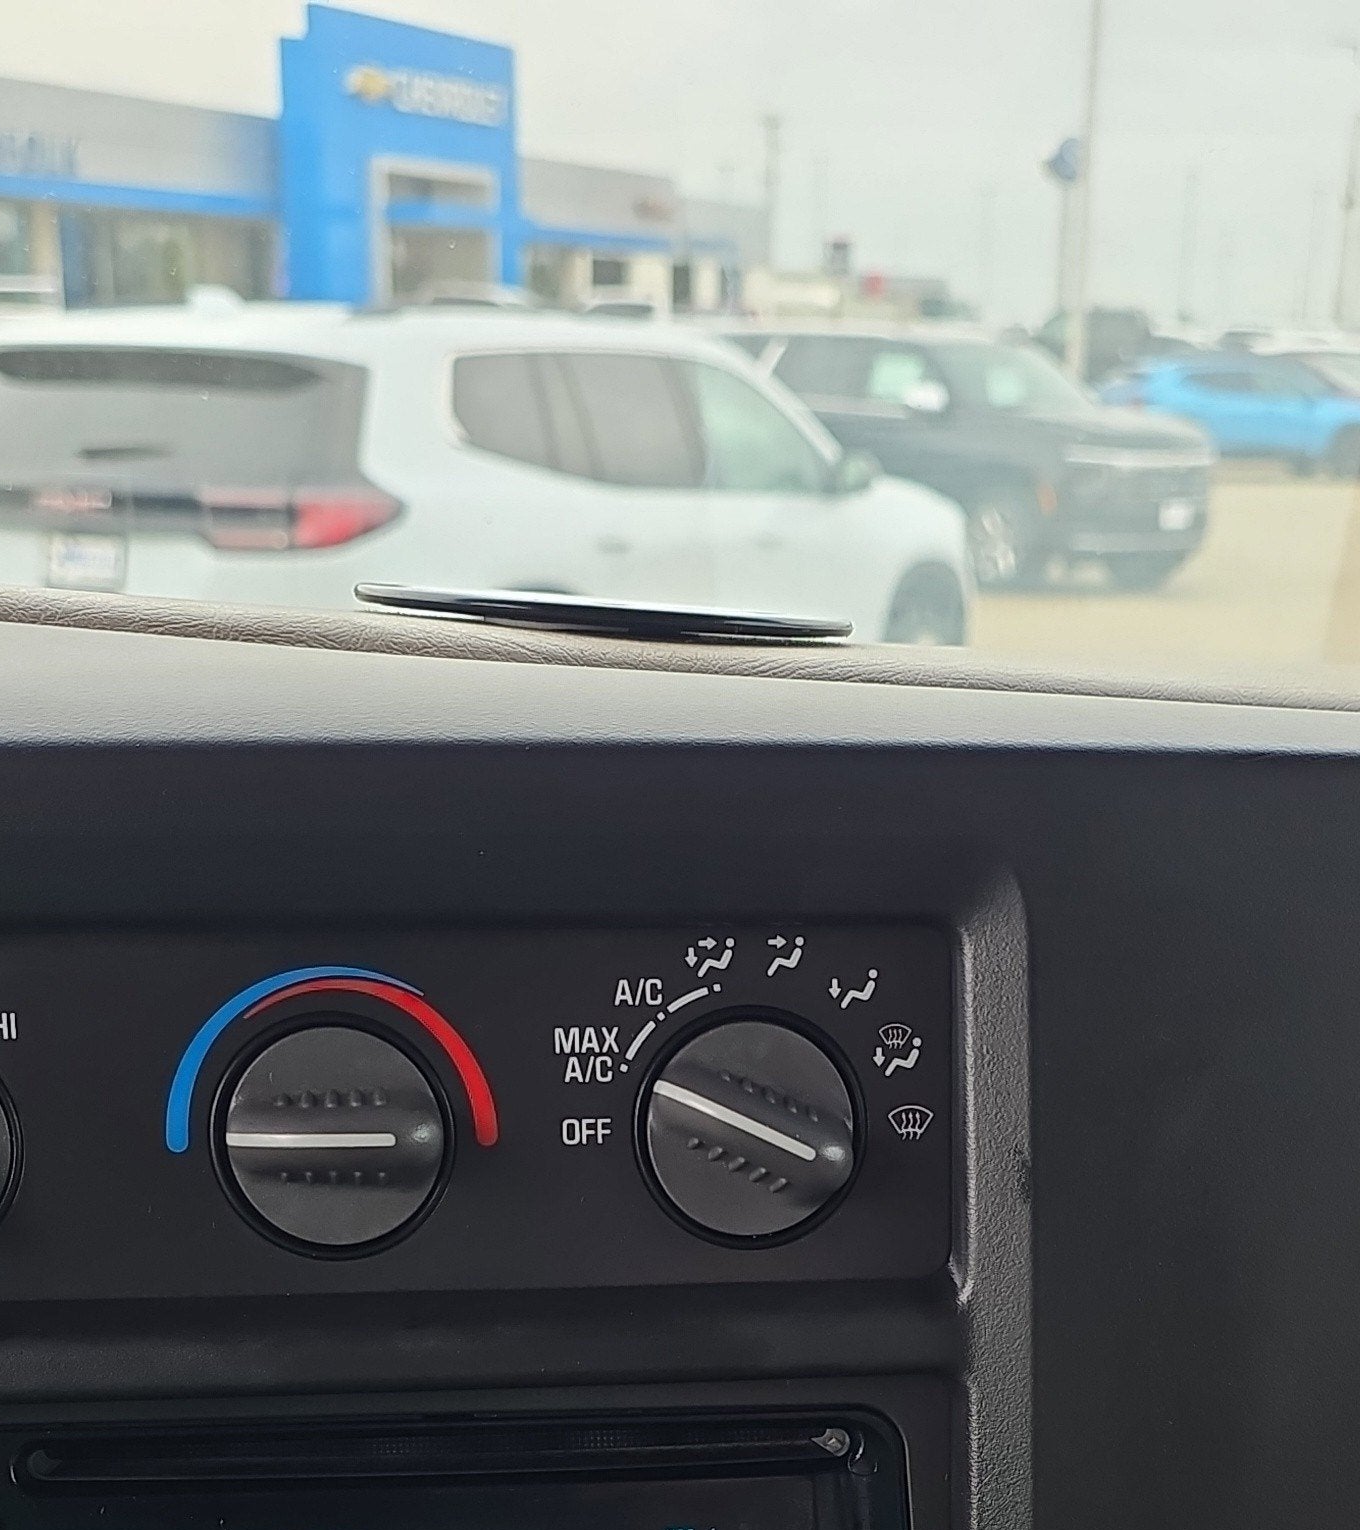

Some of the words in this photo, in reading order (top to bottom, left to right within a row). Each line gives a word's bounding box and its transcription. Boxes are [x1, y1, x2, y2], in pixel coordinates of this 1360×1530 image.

[614, 978, 663, 1006] A/C
[554, 1026, 620, 1054] MAX
[564, 1055, 613, 1083] A/C
[562, 1118, 612, 1145] OFF
